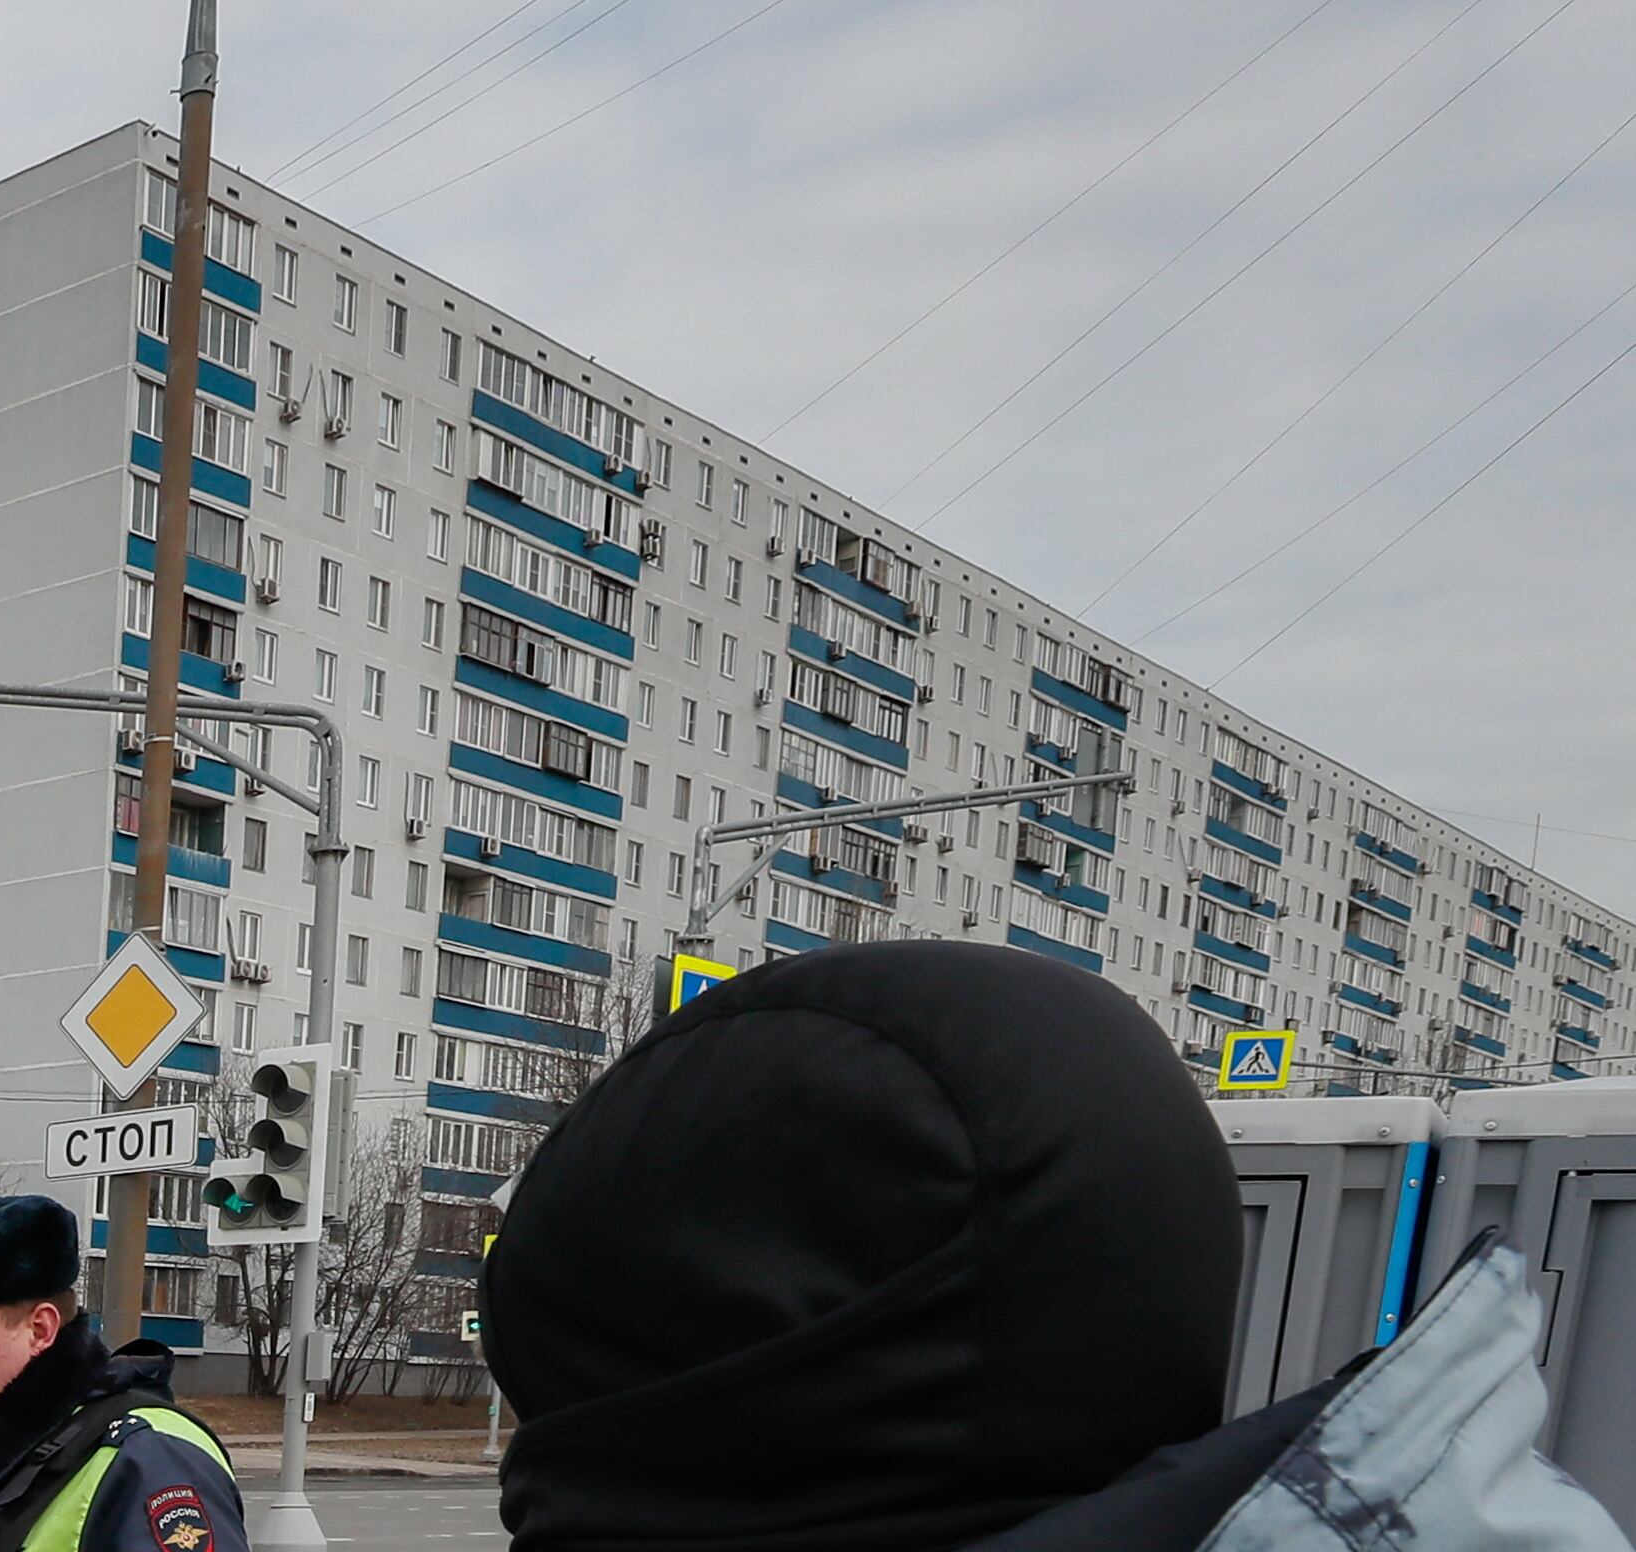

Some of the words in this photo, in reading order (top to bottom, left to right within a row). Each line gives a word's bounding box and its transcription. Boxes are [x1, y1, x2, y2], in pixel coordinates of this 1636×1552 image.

[65, 1119, 174, 1167] СТОП
[151, 1490, 193, 1509] ПОЛИЦИЯ
[159, 1508, 200, 1529] РОССИЯ
